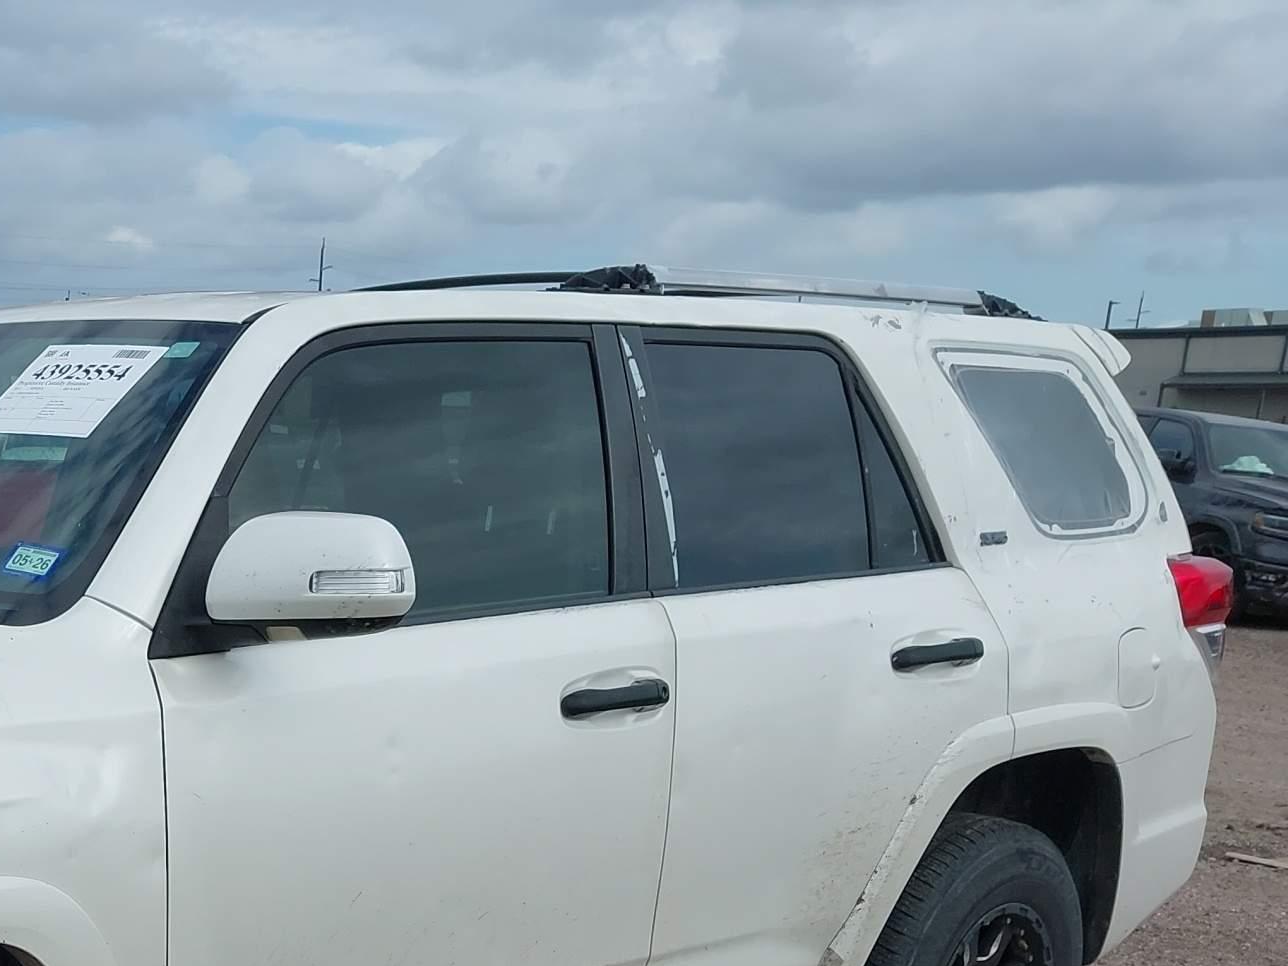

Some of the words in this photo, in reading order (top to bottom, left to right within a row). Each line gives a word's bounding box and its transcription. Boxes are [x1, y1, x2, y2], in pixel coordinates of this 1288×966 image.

[32, 363, 134, 381] 43925554
[11, 553, 31, 567] 05
[32, 557, 52, 571] 26
